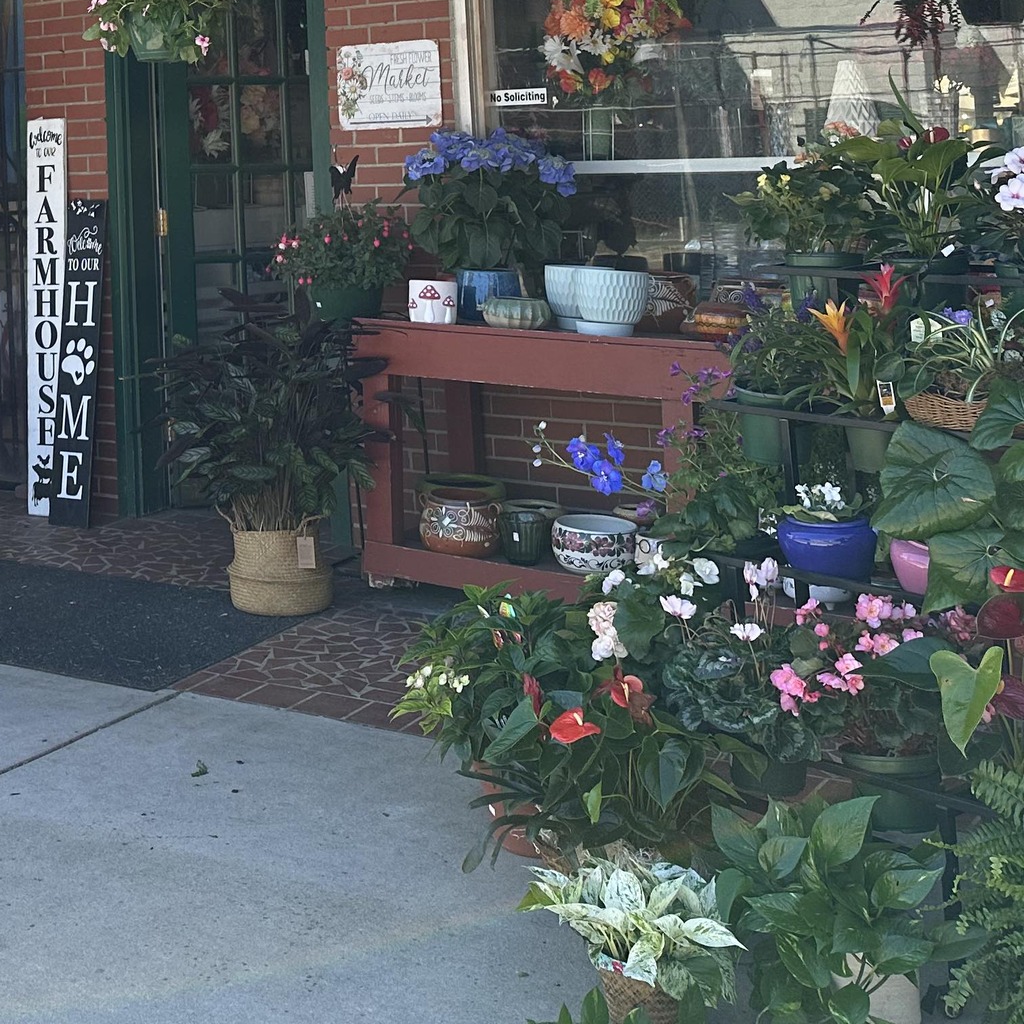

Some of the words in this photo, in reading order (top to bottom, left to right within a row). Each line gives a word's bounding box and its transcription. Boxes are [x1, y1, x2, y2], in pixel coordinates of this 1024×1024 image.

[362, 62, 434, 96] Market
[490, 93, 502, 103] No
[504, 91, 546, 102] Soliciting
[67, 225, 102, 256] Welcome
[68, 258, 79, 271] TO
[81, 258, 99, 271] OUR
[33, 164, 60, 447] FARMHOUSE
[57, 281, 97, 500] HME
